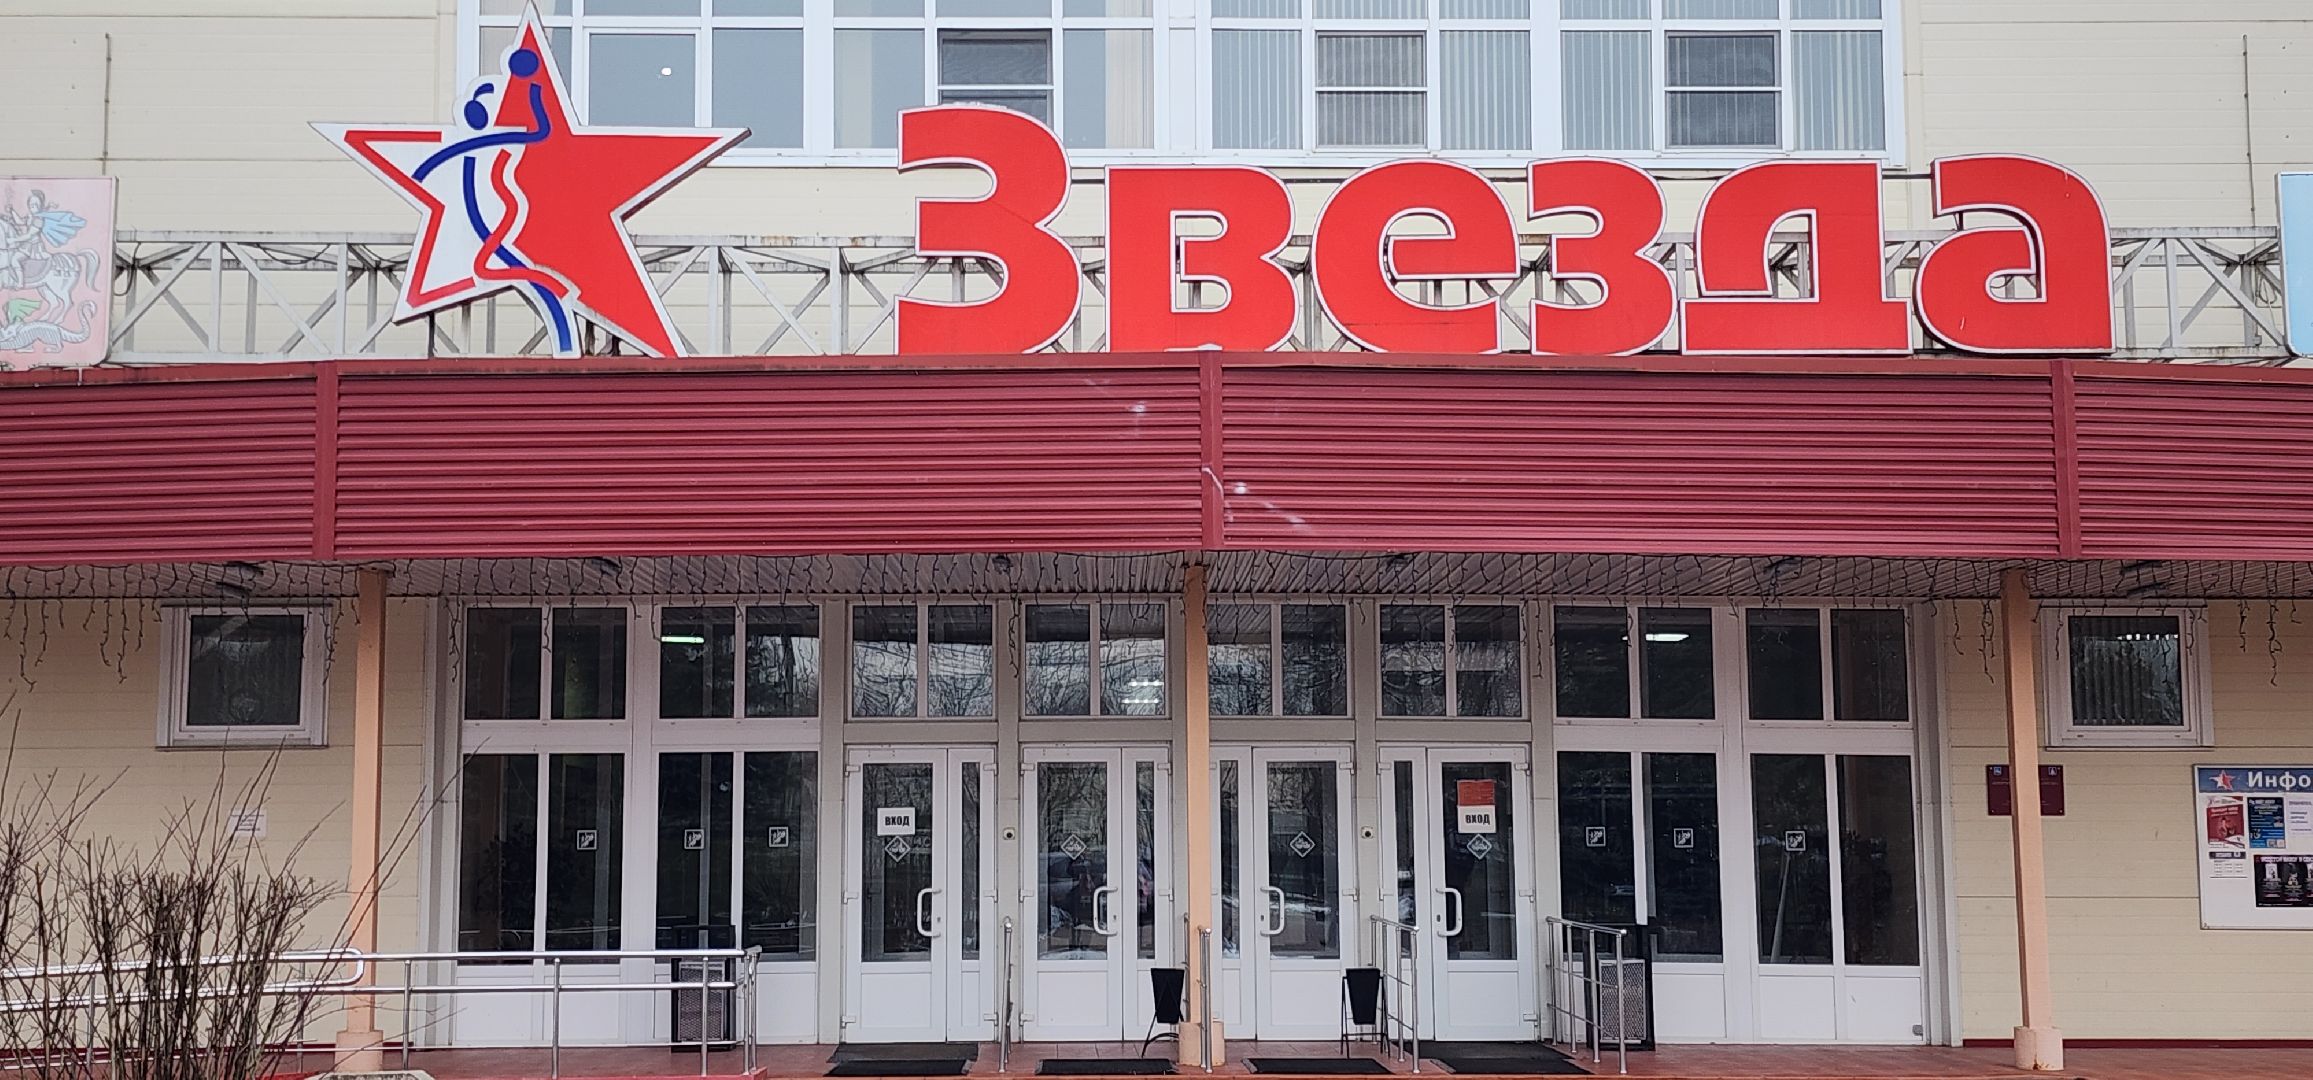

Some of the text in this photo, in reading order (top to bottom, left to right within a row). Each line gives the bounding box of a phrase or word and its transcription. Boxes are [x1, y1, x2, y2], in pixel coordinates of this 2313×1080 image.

[895, 103, 2115, 355] Звезда
[2247, 771, 2311, 791] Инфо
[885, 816, 910, 826] ВХОД
[1465, 814, 1491, 825] ВХОД
